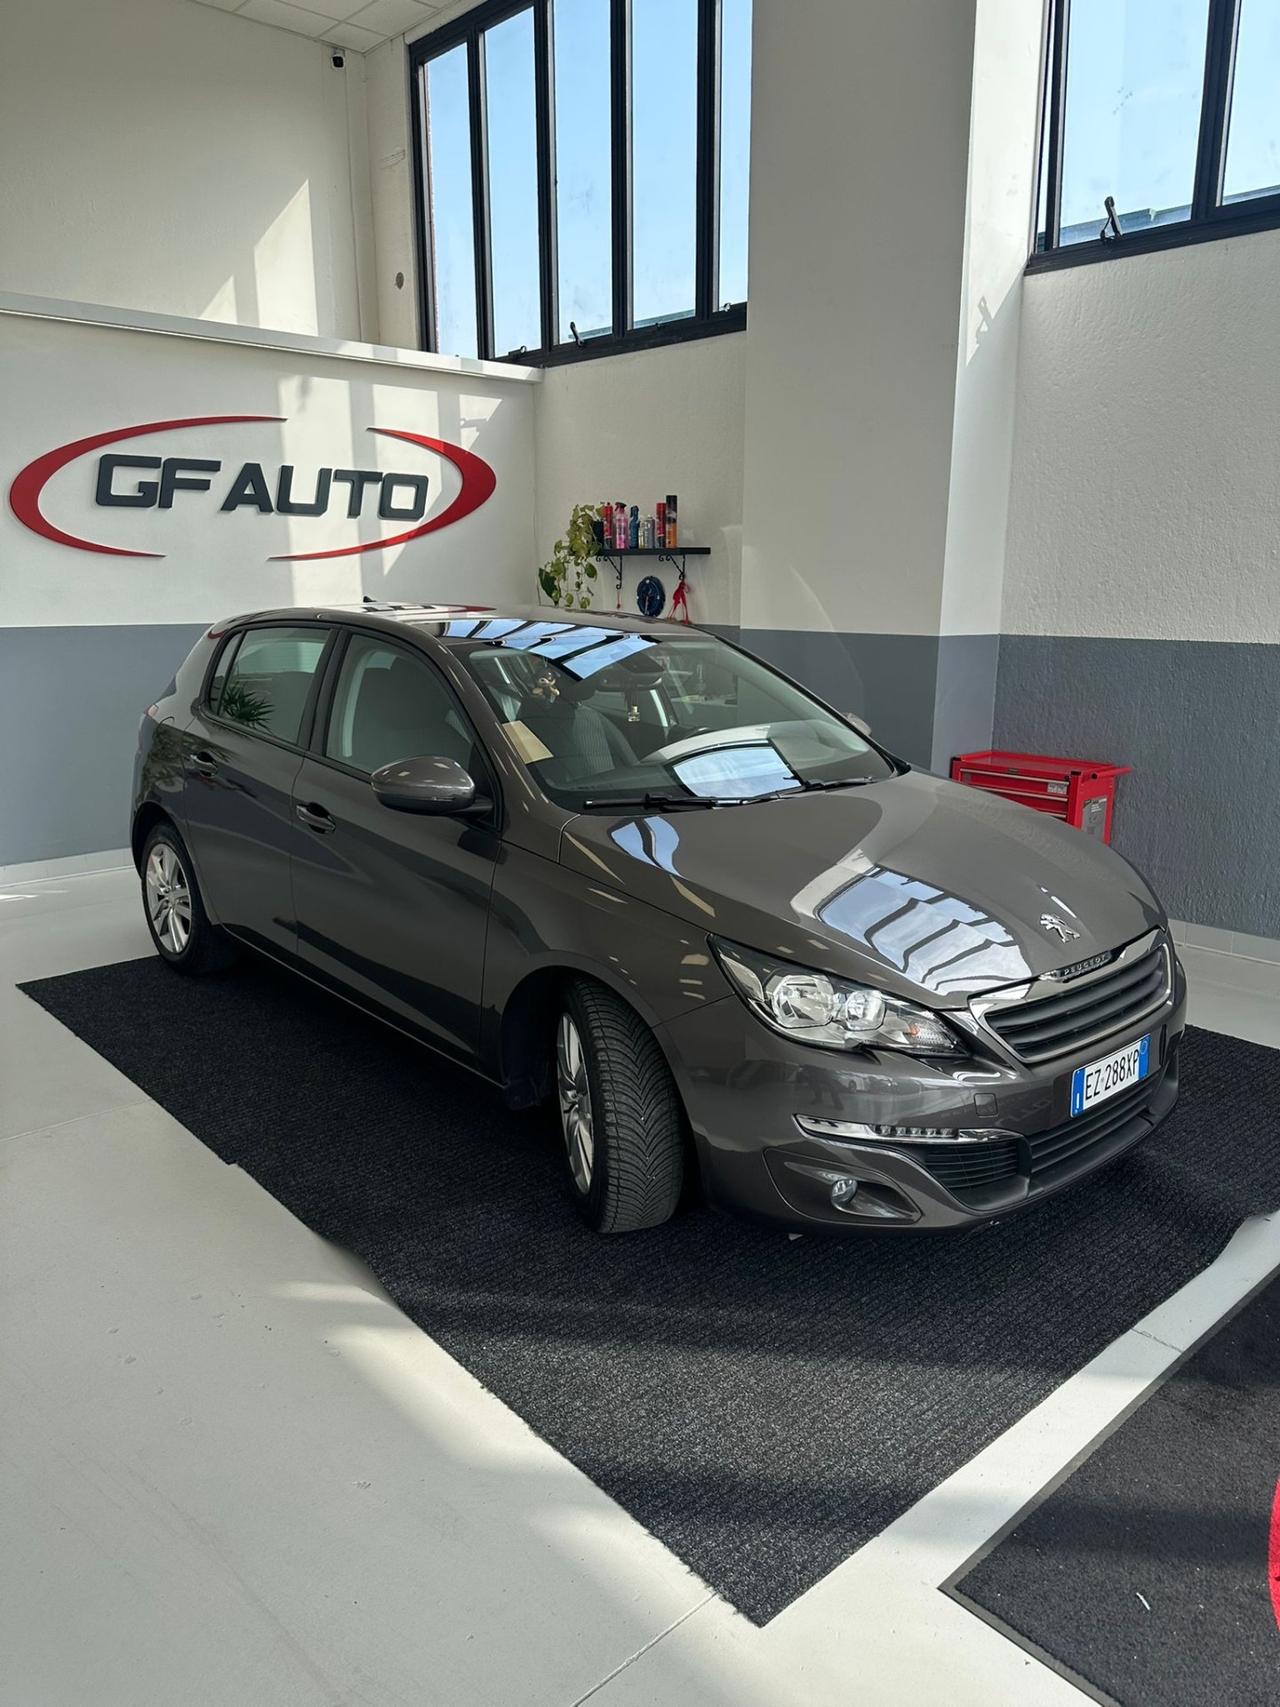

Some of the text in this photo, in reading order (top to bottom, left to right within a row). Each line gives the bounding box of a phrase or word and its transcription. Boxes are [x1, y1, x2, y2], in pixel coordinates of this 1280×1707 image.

[95, 453, 430, 521] GF AUTO
[1064, 954, 1106, 975] PEUGEOT
